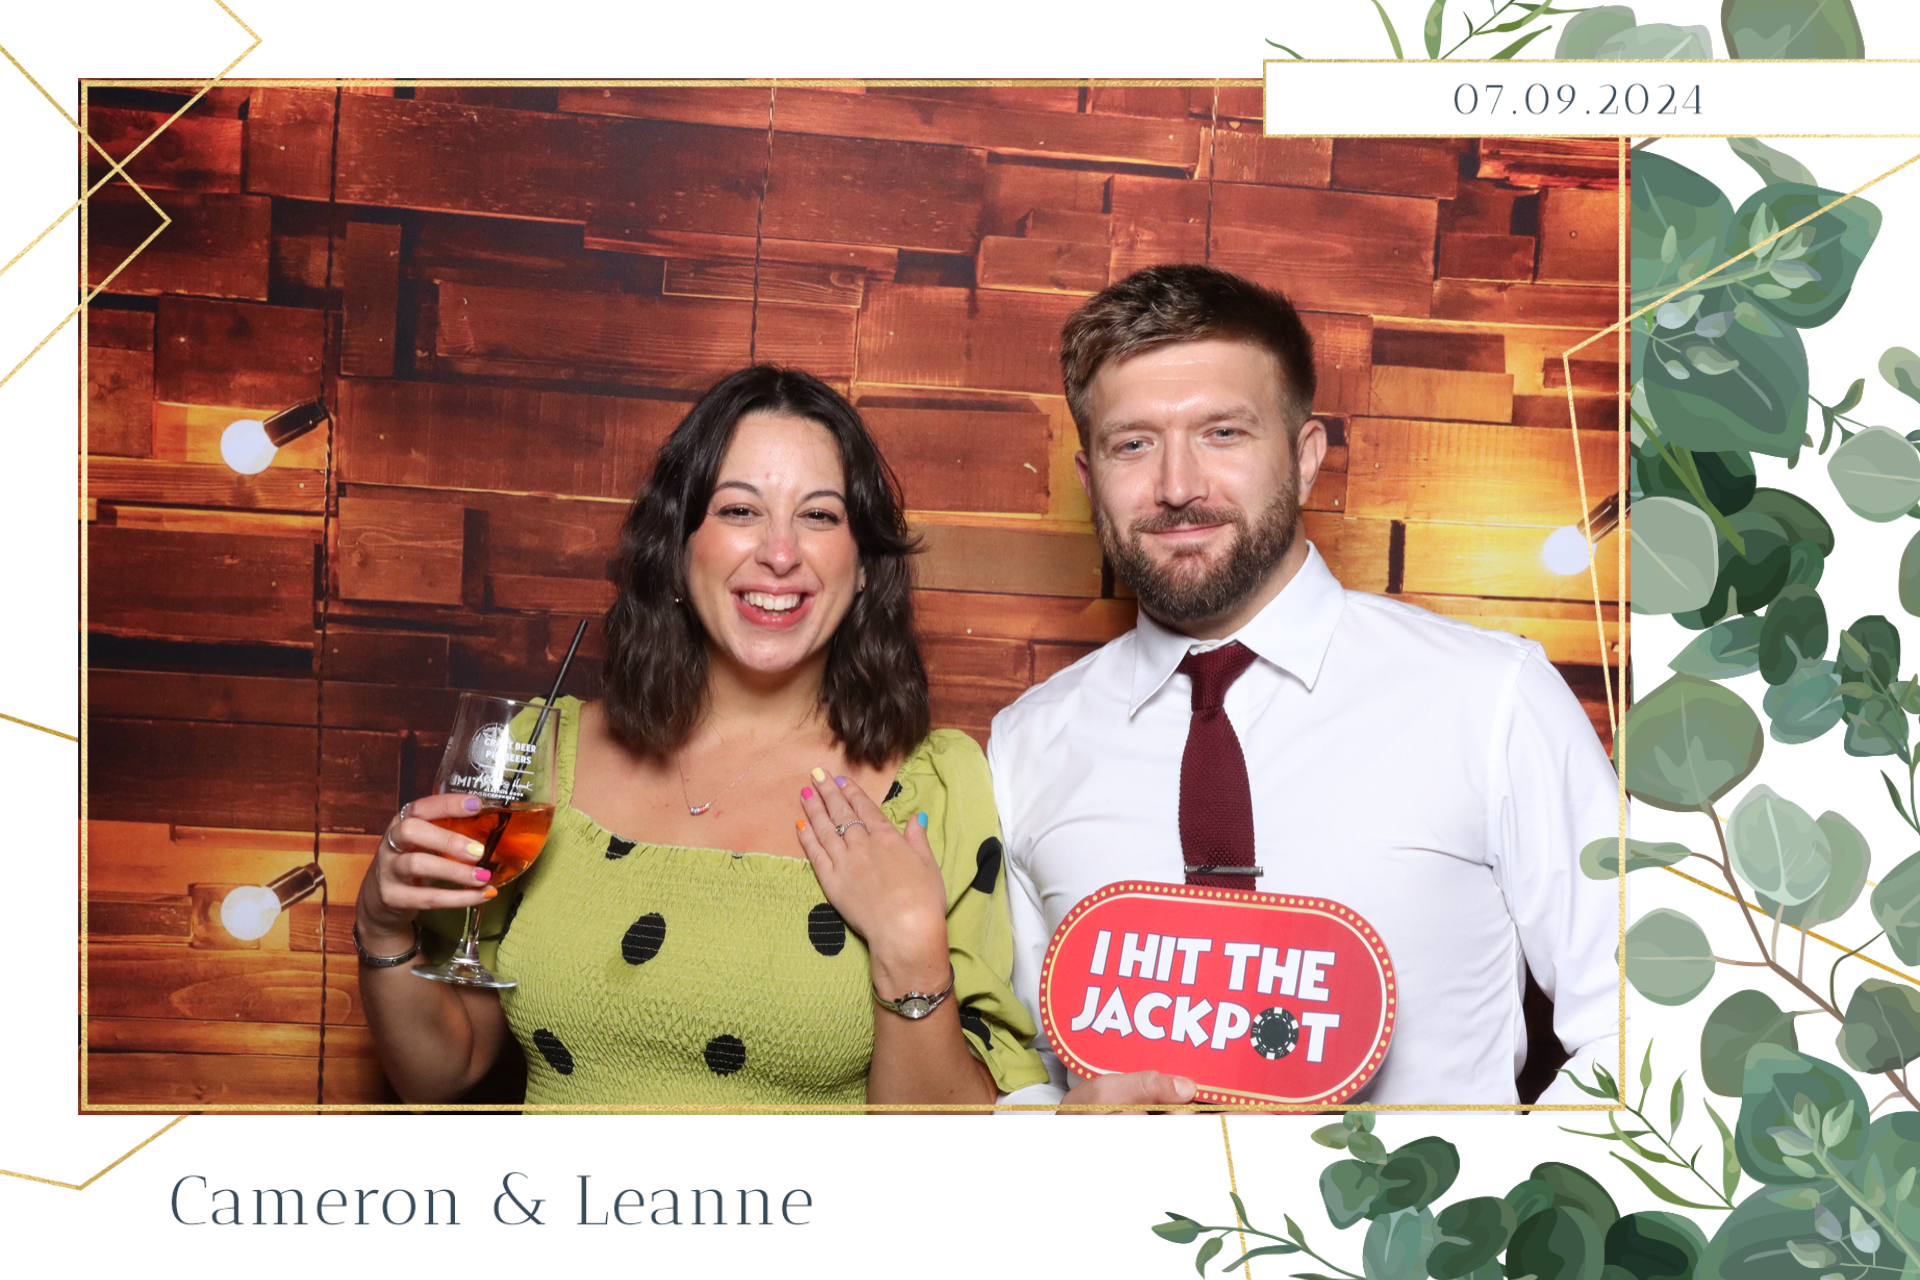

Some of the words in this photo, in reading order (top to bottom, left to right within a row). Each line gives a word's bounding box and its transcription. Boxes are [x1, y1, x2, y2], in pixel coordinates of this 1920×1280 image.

[484, 738, 513, 749] CRT
[515, 743, 536, 753] BEER
[485, 750, 532, 764] PINEERS
[1089, 929, 1113, 976] I
[1117, 931, 1214, 986] HIT
[1223, 941, 1337, 1003] THE
